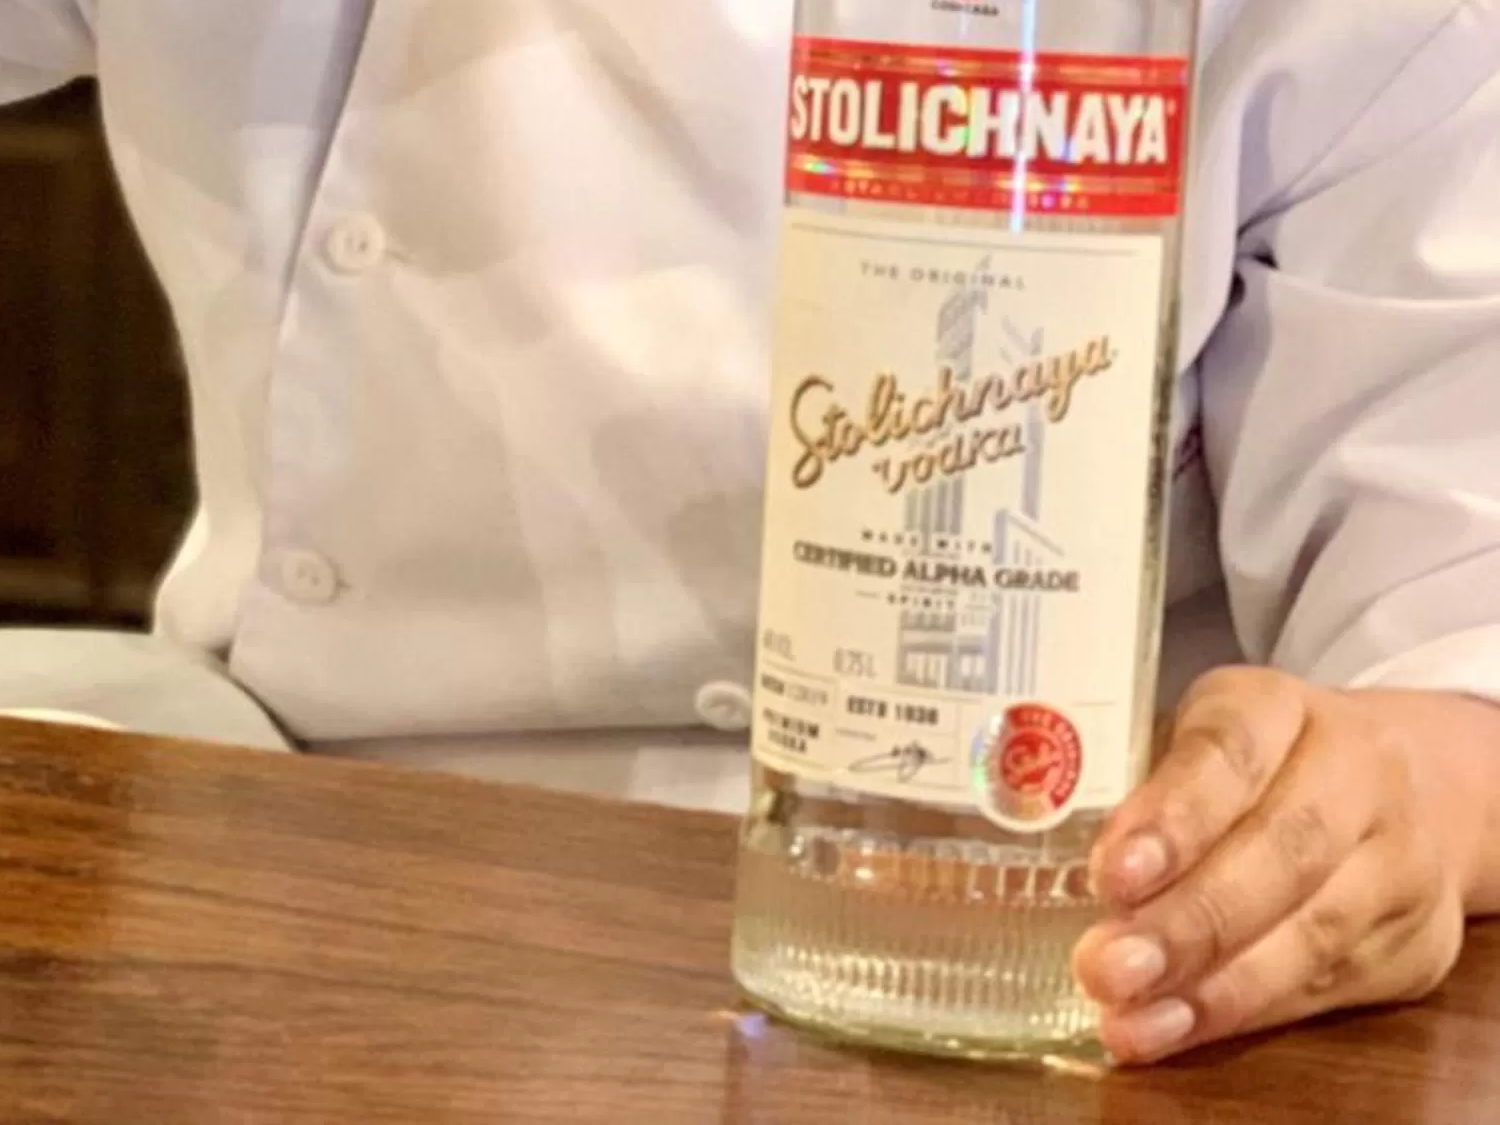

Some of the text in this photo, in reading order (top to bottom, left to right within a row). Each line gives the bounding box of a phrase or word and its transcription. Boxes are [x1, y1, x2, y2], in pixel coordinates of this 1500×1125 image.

[789, 74, 1168, 166] STOLICHNAYA
[790, 334, 1114, 490] Stolichnaya
[902, 559, 987, 588] ALPHA
[993, 568, 1082, 593] GRADE
